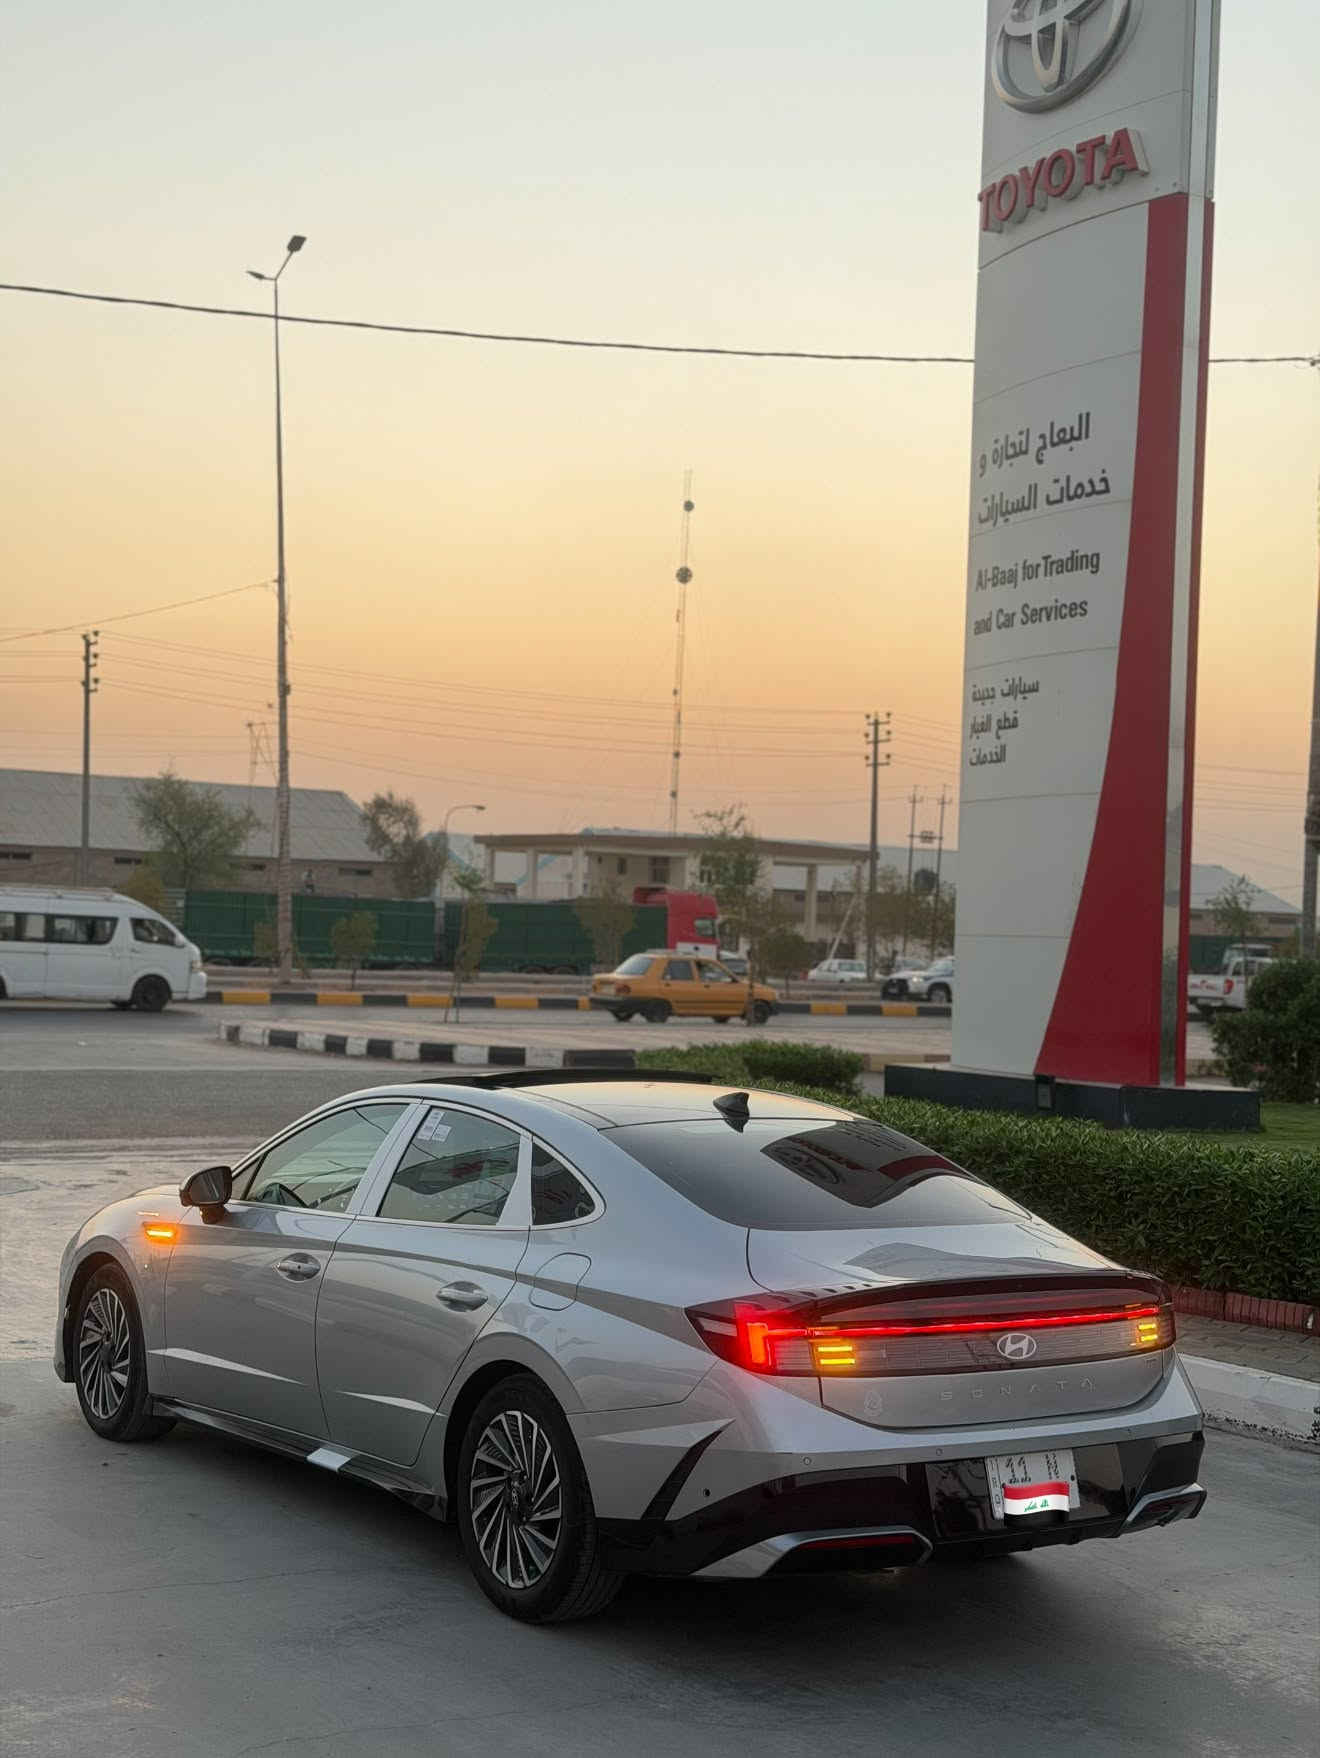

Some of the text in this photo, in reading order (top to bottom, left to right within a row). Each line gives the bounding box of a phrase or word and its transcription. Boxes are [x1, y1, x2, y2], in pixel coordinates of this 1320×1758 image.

[978, 127, 1148, 233] TOYOTA
[979, 411, 1091, 478] البعاج لتجارة و
[977, 468, 1111, 527] خدمات السيارات
[975, 549, 1101, 592] Al-Baaj for Trading
[974, 597, 1089, 636] and Car Services
[972, 675, 1040, 706] سيارات جديدة
[995, 710, 1019, 740] قطع
[968, 743, 1007, 767] الخدمات
[939, 1376, 1097, 1401] SONATA
